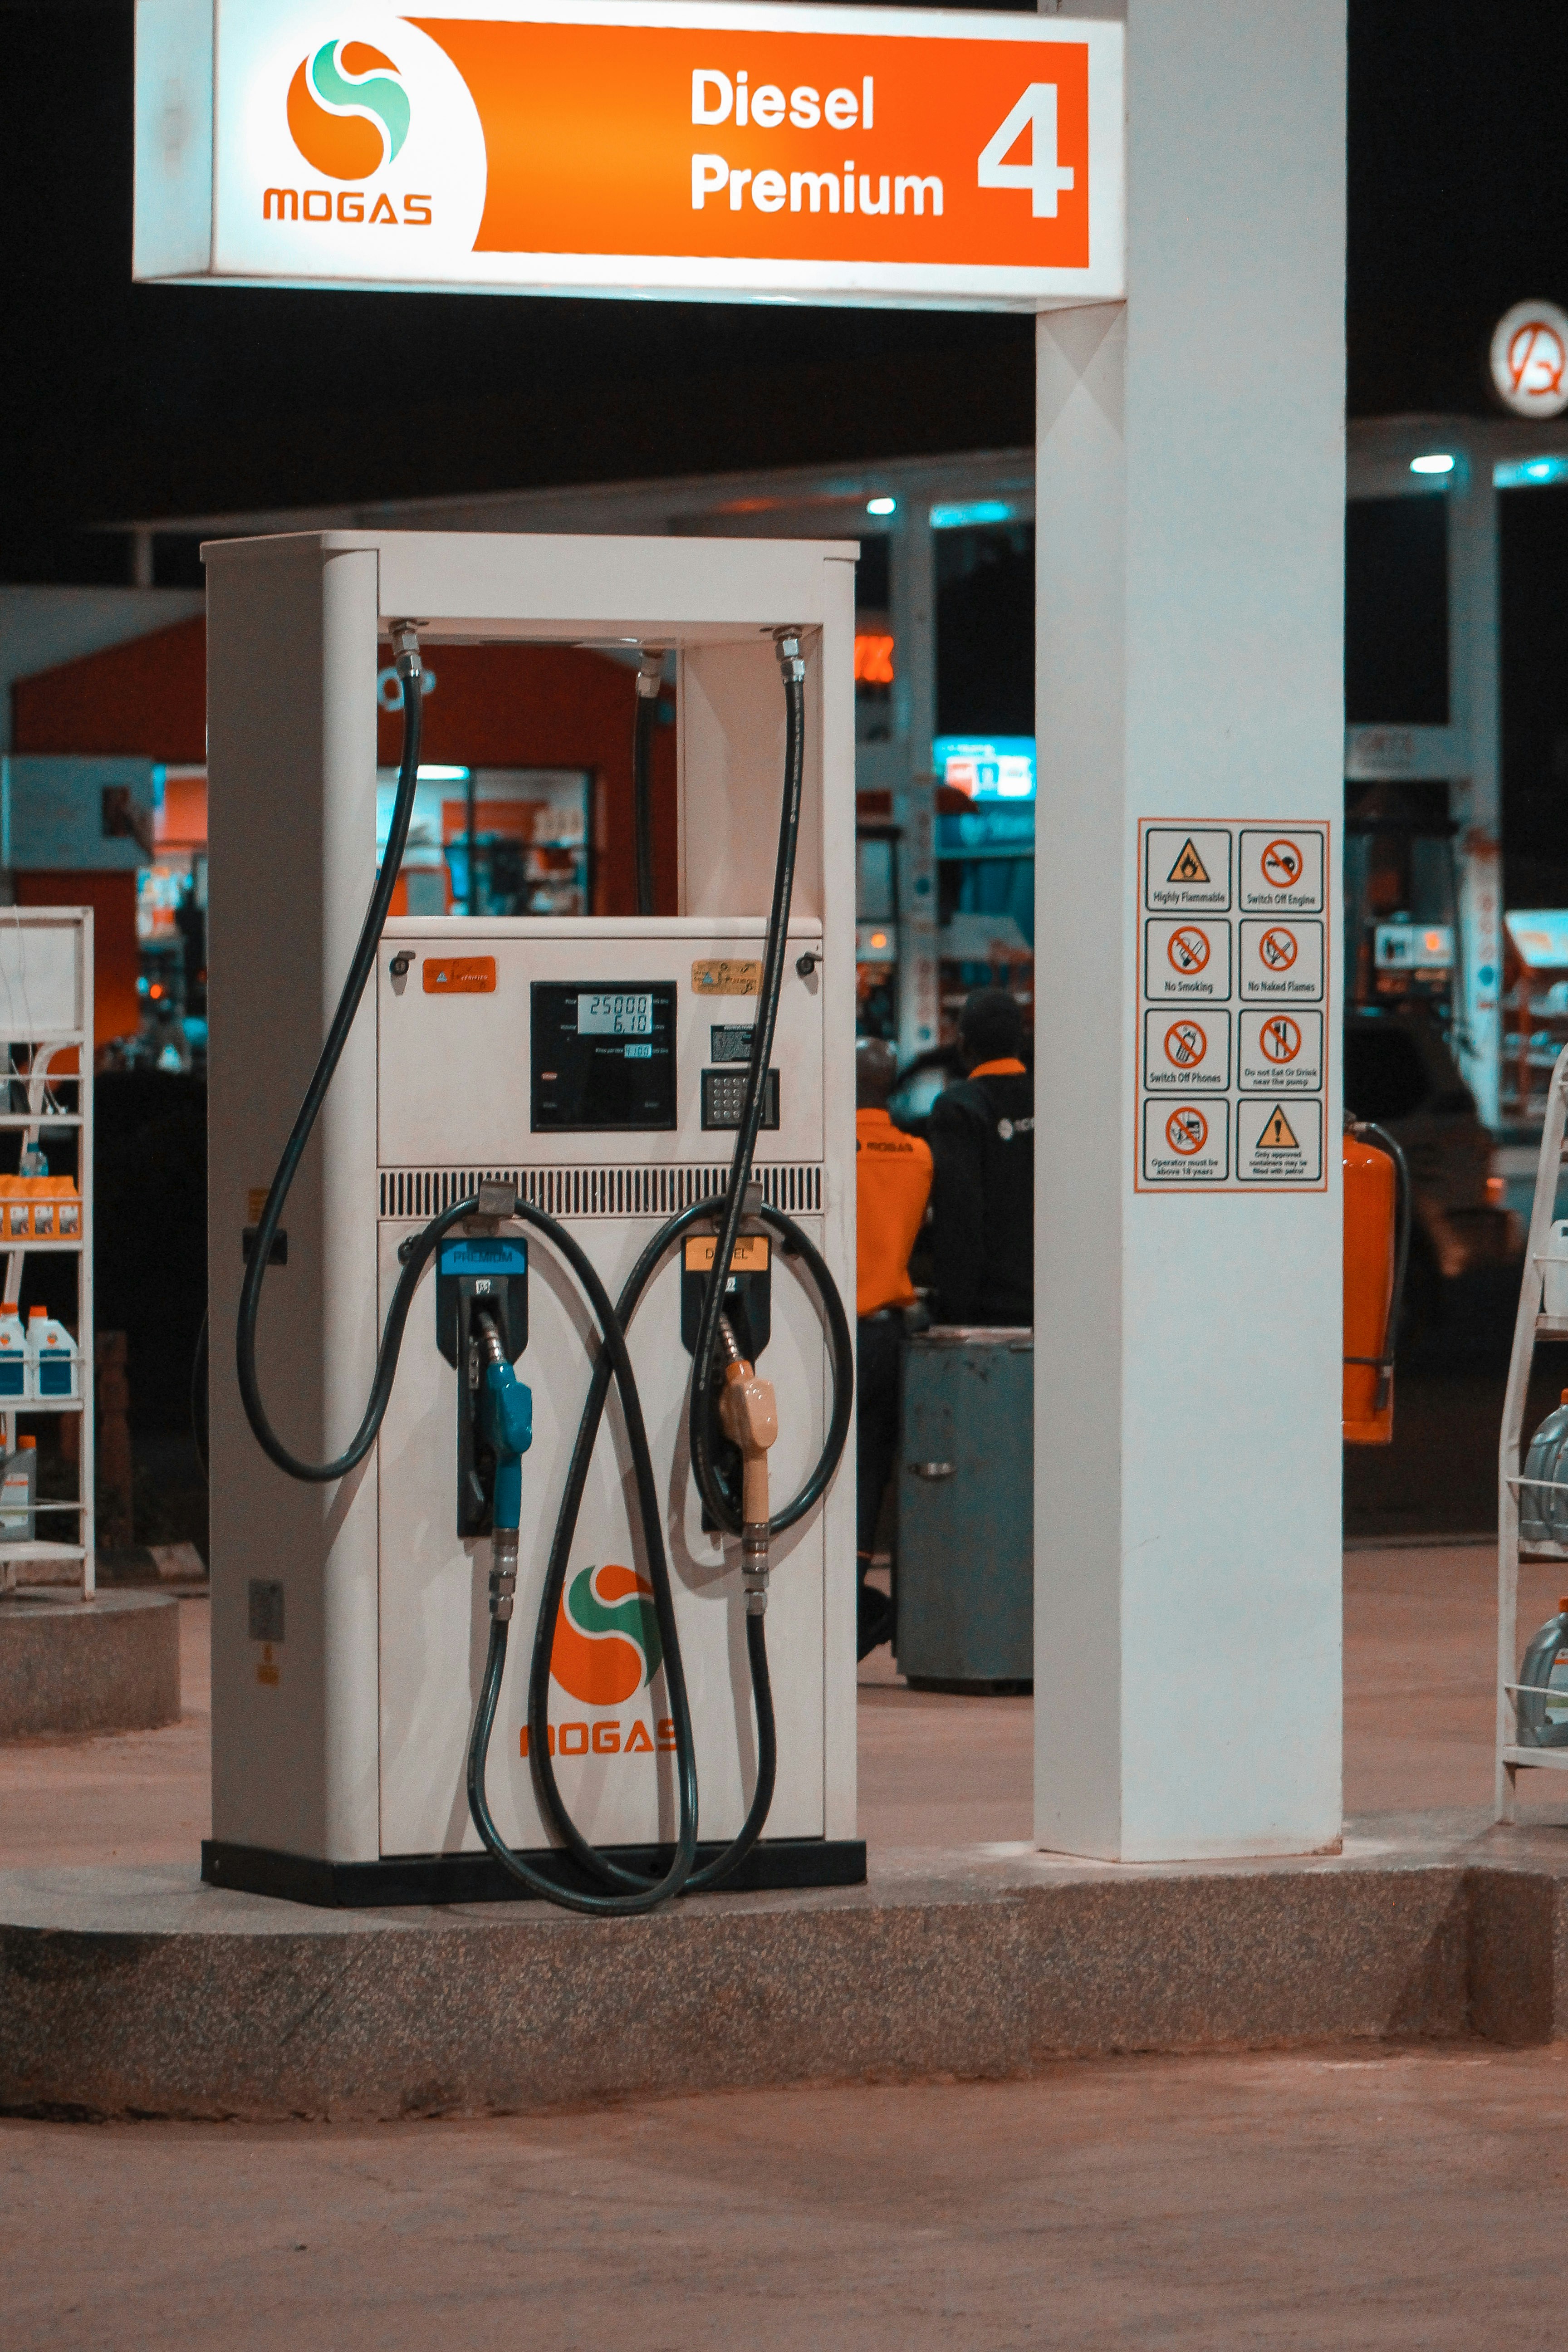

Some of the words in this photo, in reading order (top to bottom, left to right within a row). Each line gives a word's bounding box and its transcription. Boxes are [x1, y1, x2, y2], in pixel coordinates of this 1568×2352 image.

[691, 68, 873, 130] Diesel
[977, 82, 1074, 218] 4
[691, 153, 943, 216] Premium
[263, 188, 432, 225] MOGAS
[1153, 891, 1179, 904] Highly
[1181, 891, 1225, 902] Flammable
[1248, 893, 1272, 904] Switch
[1274, 893, 1286, 903] Off
[1288, 894, 1315, 906] Engine
[1164, 981, 1176, 991] No
[1178, 981, 1213, 994] Smoking
[1248, 981, 1259, 991] No
[1260, 981, 1285, 991] Naked
[1287, 981, 1315, 991] Flames
[590, 996, 647, 1014] 25000
[1149, 1071, 1176, 1082] Switch
[1178, 1071, 1190, 1082] Off
[1192, 1072, 1220, 1083] Phones
[1152, 1158, 1186, 1167] Operator
[454, 1251, 512, 1263] PREMIUM
